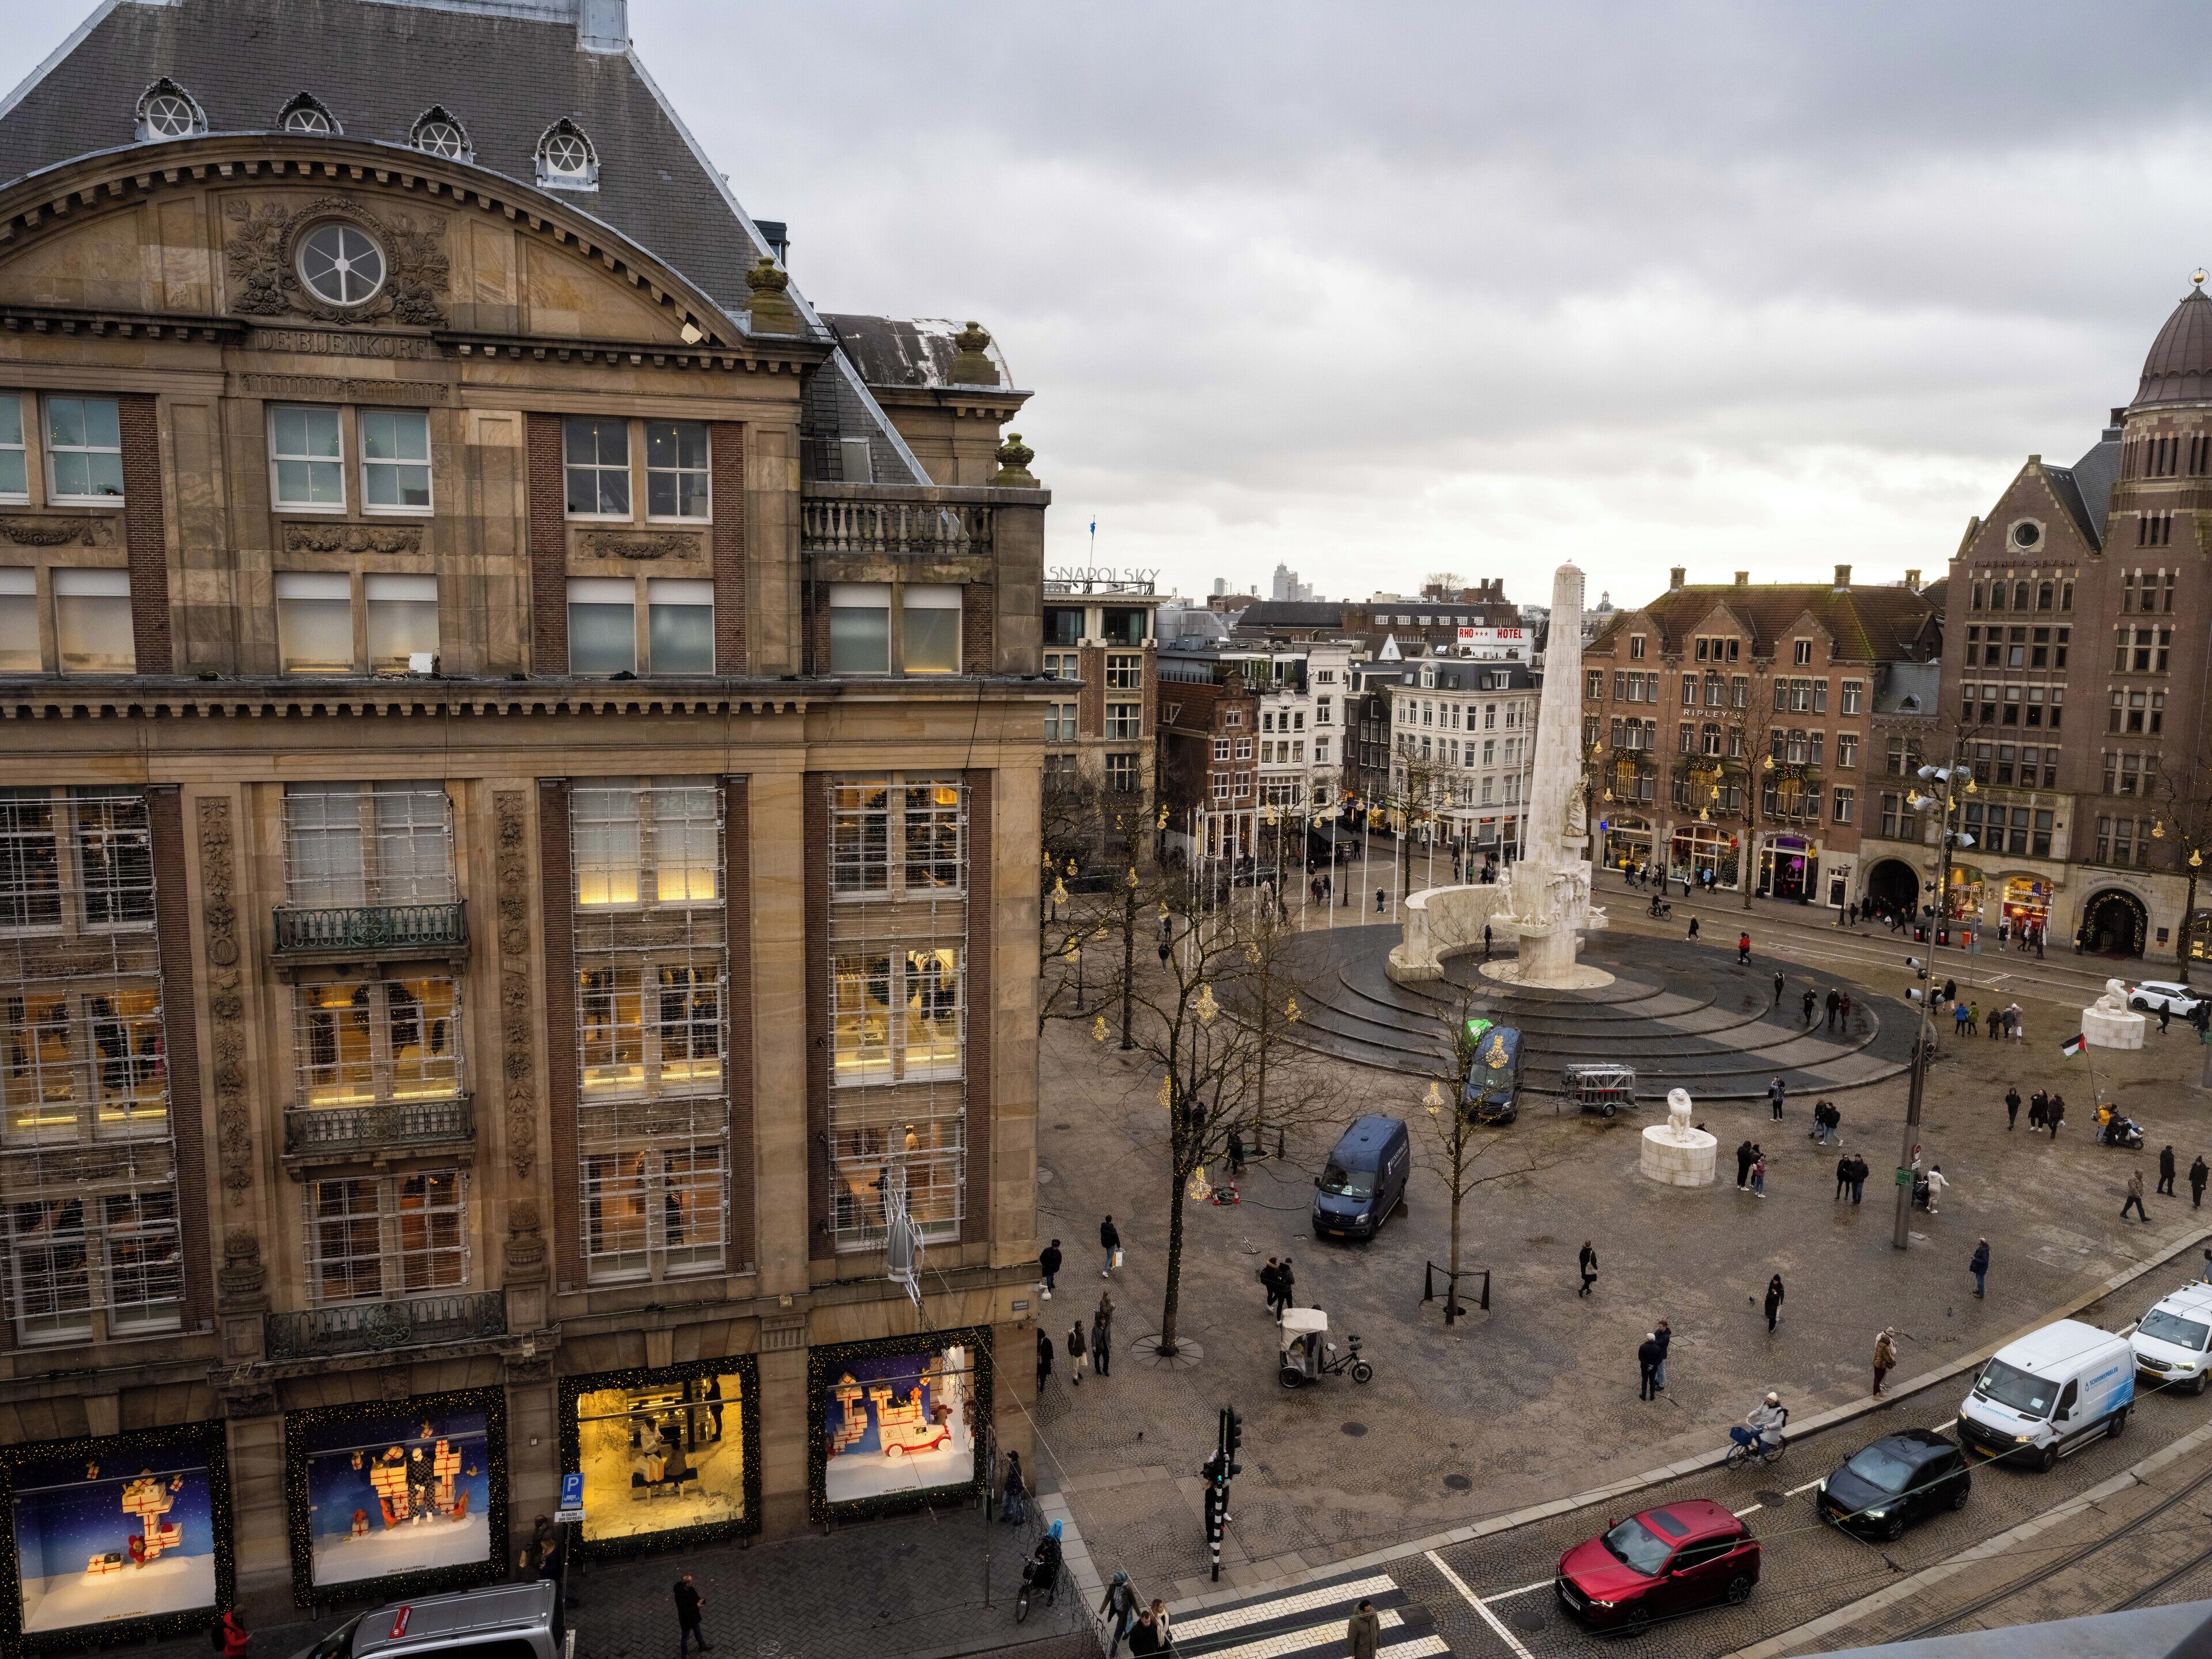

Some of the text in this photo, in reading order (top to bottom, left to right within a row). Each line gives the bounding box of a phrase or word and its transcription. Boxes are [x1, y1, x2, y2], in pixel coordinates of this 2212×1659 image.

[256, 330, 426, 358] DE BIJENKORF
[1972, 559, 2075, 568] TWENTY SEVEN
[1459, 628, 1522, 639] RHO HOTEL
[1963, 885, 1980, 893] TICKETS
[1982, 1406, 2018, 1422] SCHOONSPOELER
[567, 1477, 579, 1492] P
